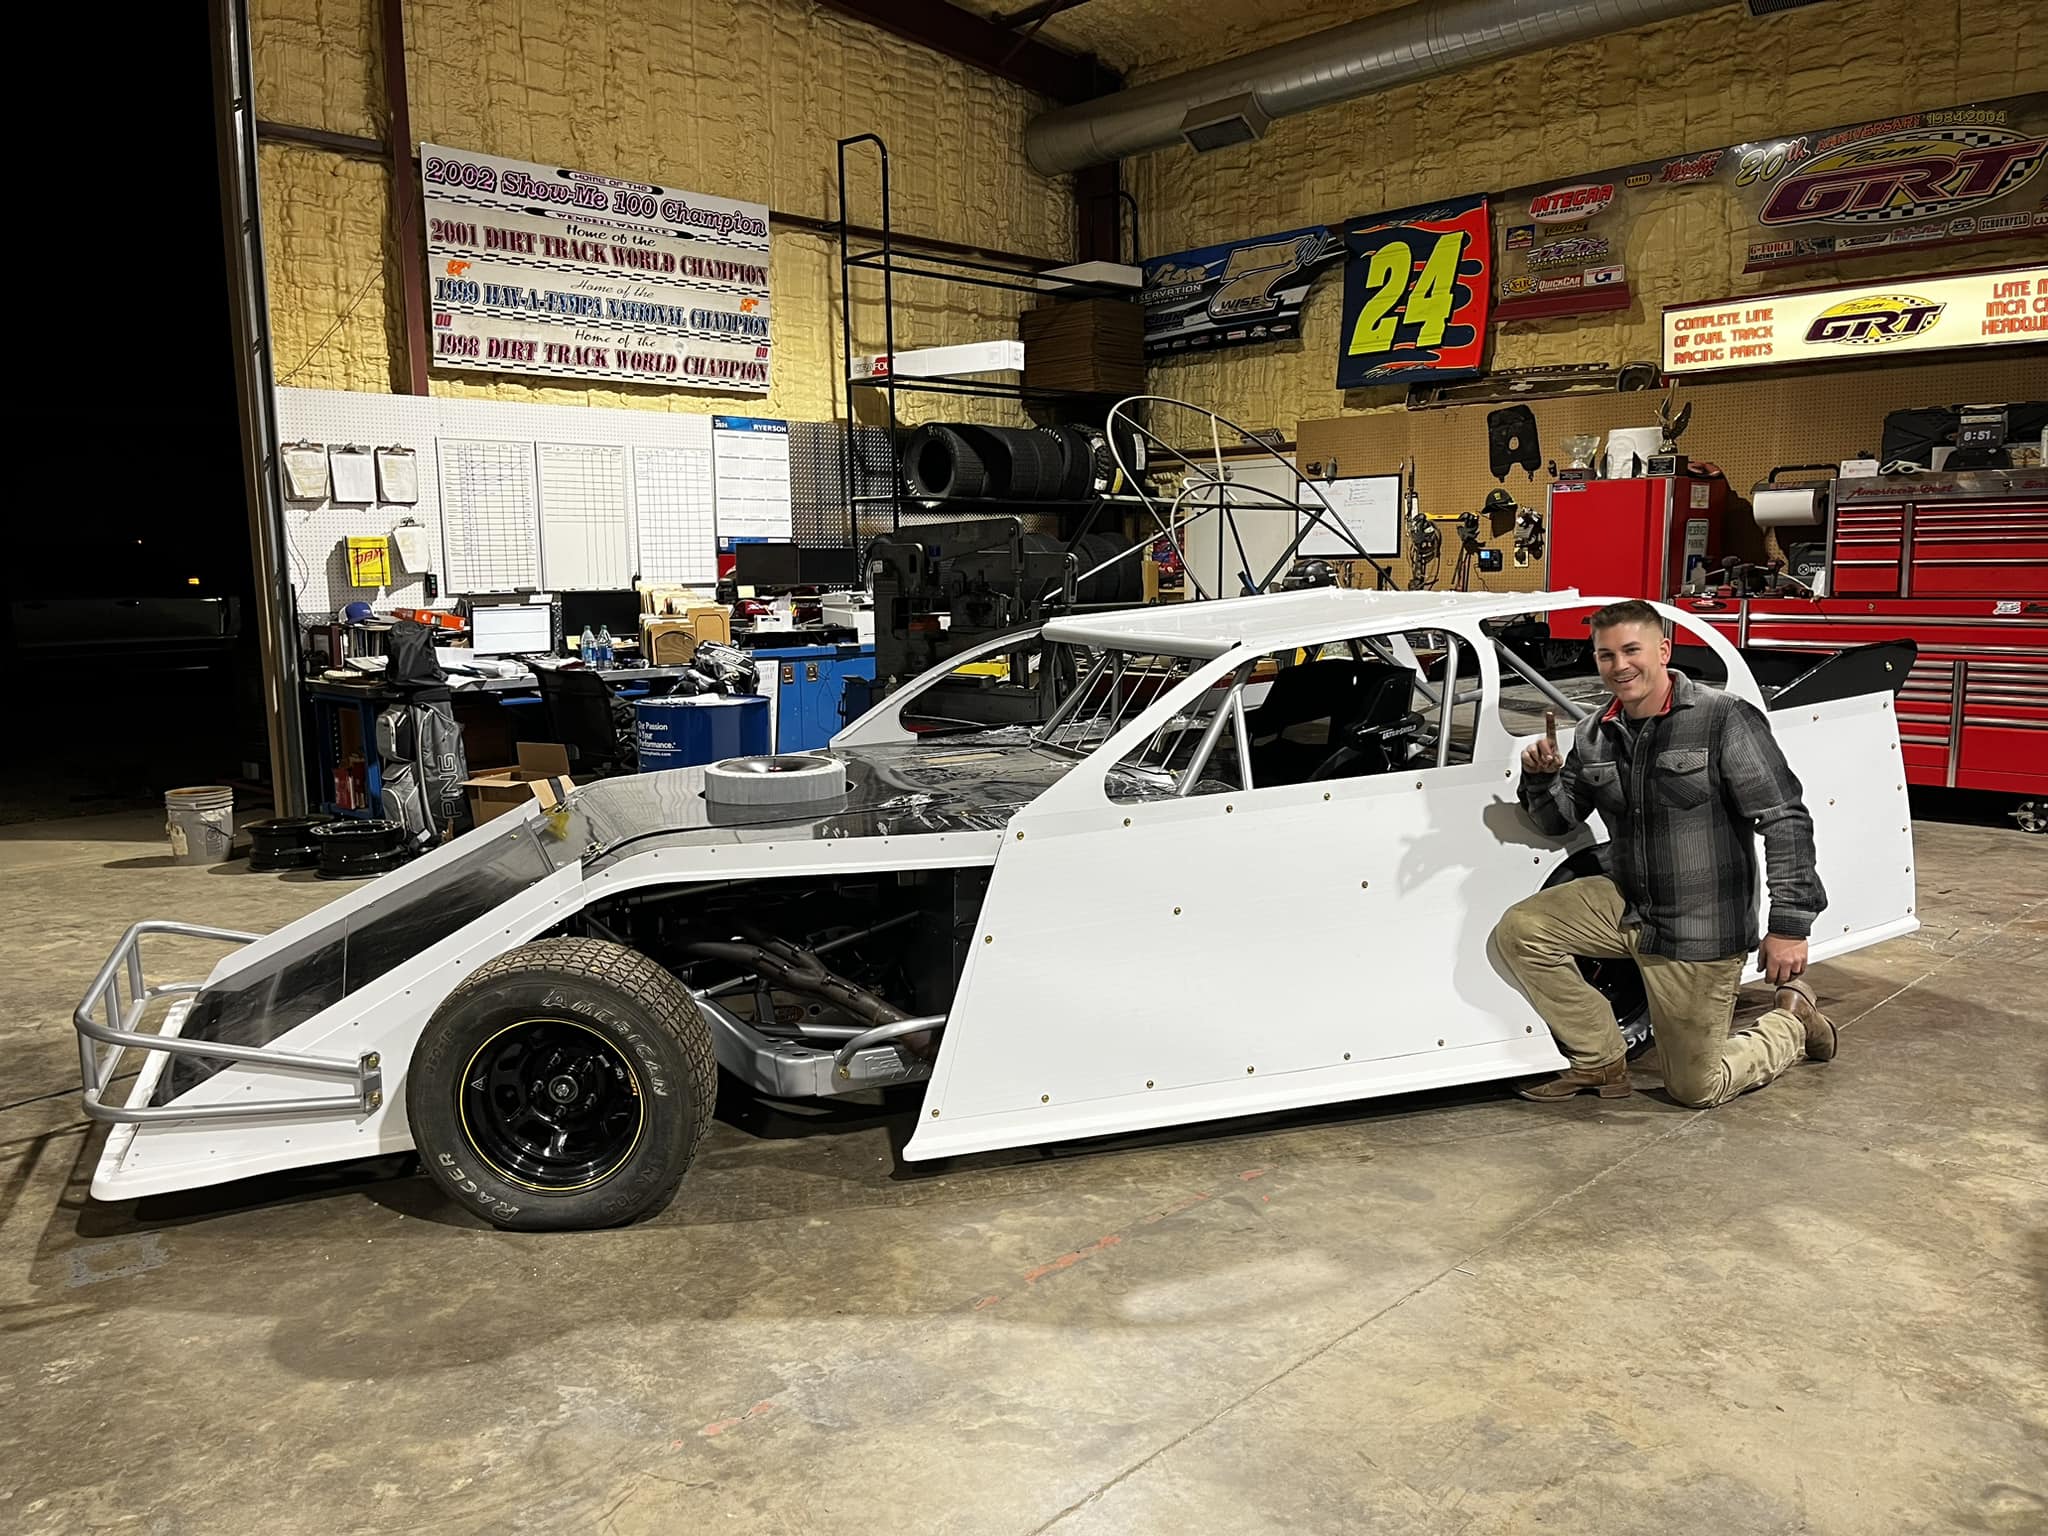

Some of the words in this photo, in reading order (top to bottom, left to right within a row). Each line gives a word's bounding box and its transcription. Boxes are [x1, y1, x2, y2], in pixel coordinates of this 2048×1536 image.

[1735, 137, 1811, 187] 20th
[1815, 113, 1921, 154] ANNIVERSARY
[425, 157, 497, 194] 2002
[501, 170, 608, 211] Show-Me
[613, 190, 658, 219] 100
[660, 199, 768, 238] Champion
[1530, 184, 1614, 214] INTEGRA
[556, 212, 613, 226] WENDELL
[616, 222, 670, 235] WALLACE
[566, 224, 607, 240] Home
[611, 233, 628, 246] of
[633, 235, 656, 248] the
[1750, 240, 1793, 255] G-FORCE
[430, 218, 479, 248] 2001
[483, 225, 537, 256] DIRT
[540, 234, 609, 266] TRACK
[610, 245, 677, 274] WORLD
[680, 254, 768, 288] CHAMPION
[570, 279, 613, 295] Home
[616, 284, 631, 298] of
[634, 286, 655, 298] the
[1348, 231, 1466, 356] 24
[1993, 280, 2031, 299] LATE
[435, 277, 480, 305] 1999
[483, 283, 605, 319] HAV-A-TAMPA
[606, 297, 687, 329] NATIONAL
[689, 308, 770, 337] CHAMPION
[1221, 296, 1262, 310] WISE
[1986, 298, 2026, 317] IMCA
[1674, 312, 1741, 331] COMPLETE
[1746, 308, 1774, 323] LINE
[1802, 302, 1948, 344] GRT
[575, 329, 611, 344] Home
[617, 334, 630, 348] of
[637, 336, 656, 348] the
[1674, 335, 1690, 348] OF
[1694, 331, 1726, 346] OVAL
[1731, 325, 1774, 342] TRACK
[437, 333, 480, 358] 1998
[487, 337, 538, 362] DIRT
[544, 343, 609, 368] TRACK
[615, 350, 677, 374] WORLD
[684, 356, 768, 383] CHAMPION
[1673, 348, 1725, 365] RACING
[1730, 342, 1773, 359] PARTS
[753, 423, 787, 433] RYERSON
[646, 721, 669, 731] Passion
[437, 753, 463, 819] PING
[541, 988, 669, 1098] AMERICAN
[438, 1151, 520, 1222] RACER
